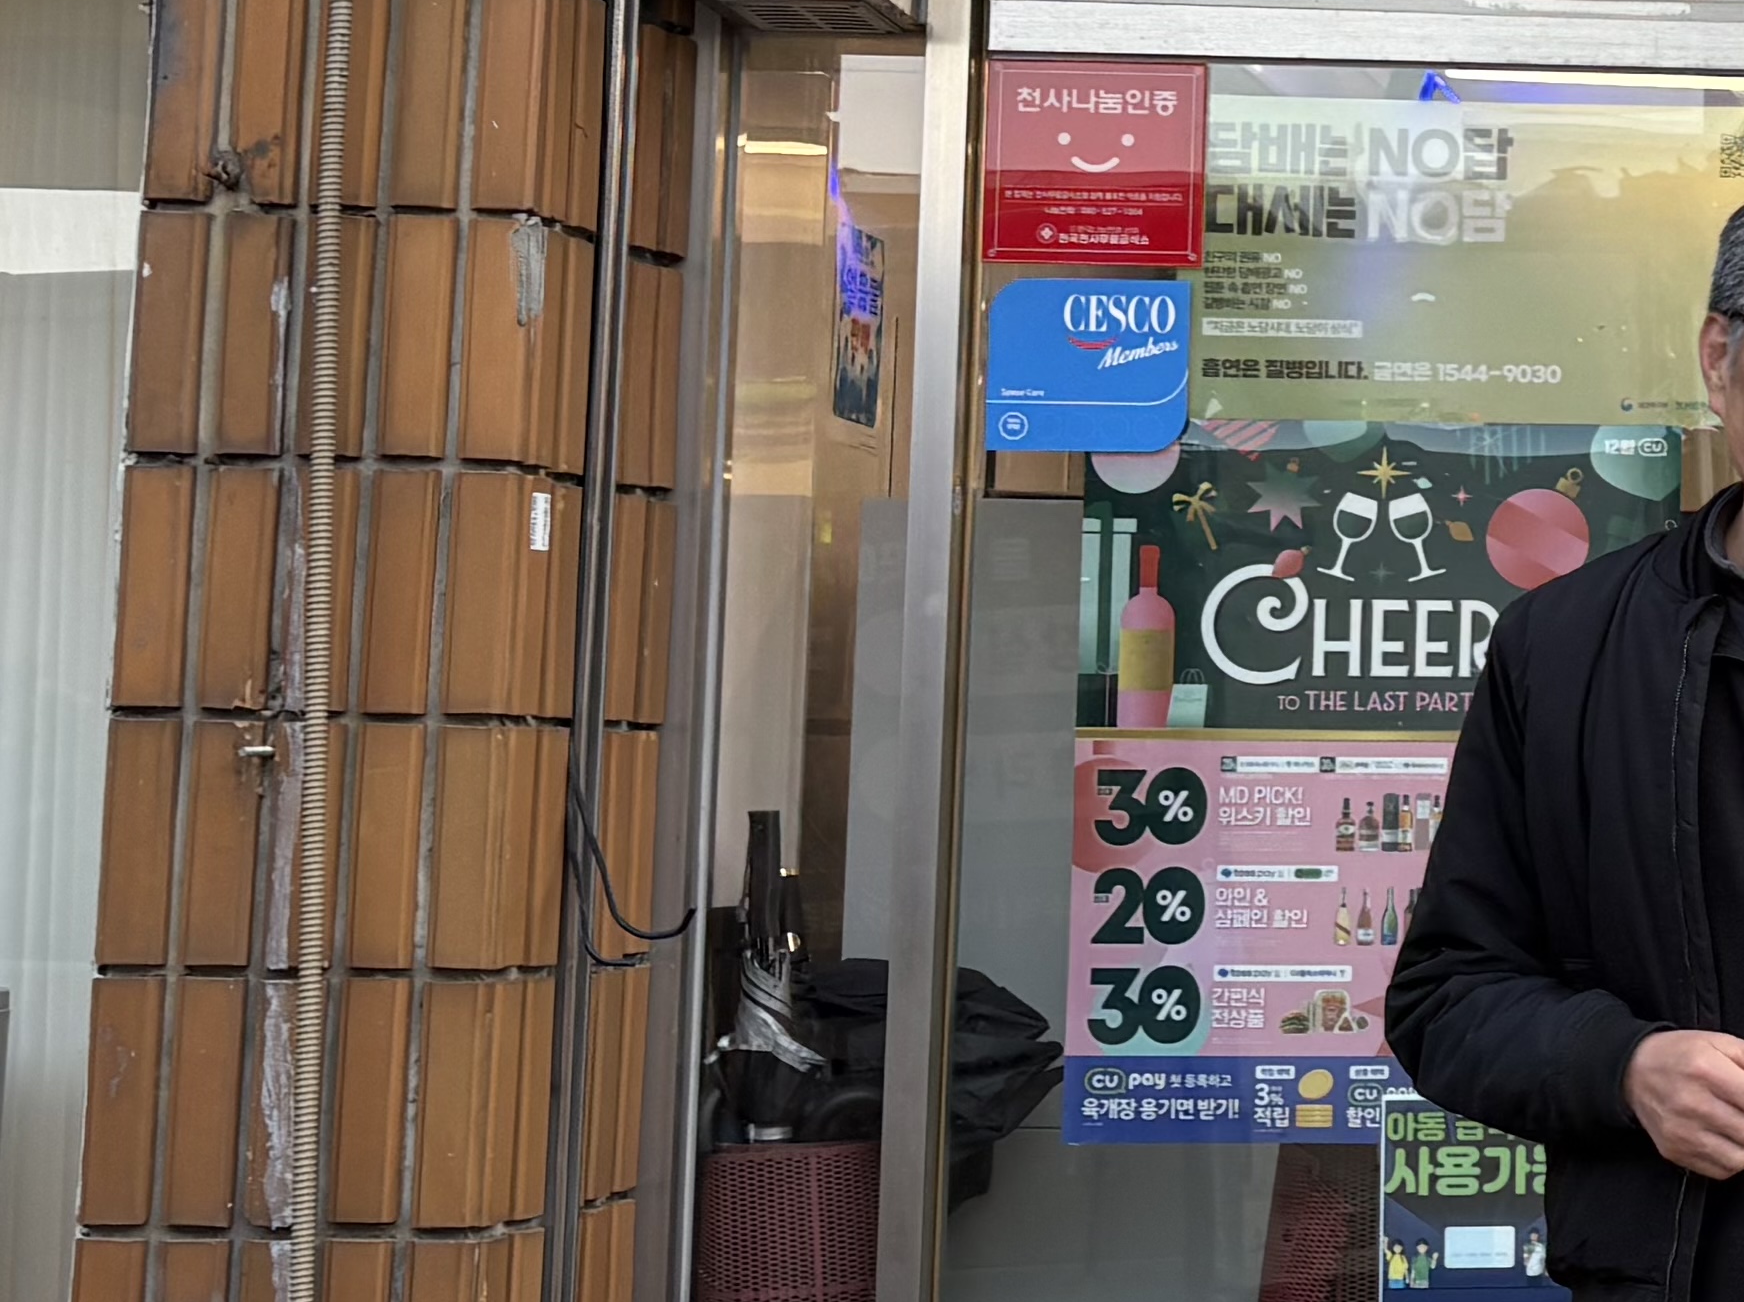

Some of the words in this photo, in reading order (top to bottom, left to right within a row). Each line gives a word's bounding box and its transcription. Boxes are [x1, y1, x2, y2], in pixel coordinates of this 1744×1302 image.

[1016, 86, 1178, 116] 천사나눔인증
[1207, 120, 1349, 177] 담배는
[1367, 127, 1514, 181] NO답
[1205, 183, 1356, 239] 대세는
[1366, 188, 1513, 246] NO담
[1263, 253, 1281, 263] NO
[1284, 268, 1303, 279] NO
[1289, 284, 1307, 294] NO
[1063, 294, 1176, 334] CESCO
[1272, 299, 1291, 309] NO
[1097, 337, 1179, 370] Members
[1201, 357, 1260, 378] 흡연은
[1265, 359, 1369, 380] 질병입니다.
[1373, 360, 1433, 382] 금연은
[1436, 362, 1562, 384] 1544-9030
[1604, 439, 1635, 455] 12월
[1277, 694, 1299, 710] TO
[1304, 690, 1347, 711] THE
[1353, 690, 1409, 712] LAST
[1219, 786, 1248, 804] MD
[1253, 786, 1304, 804] PICK!
[1218, 807, 1271, 826] 위스키
[1276, 807, 1312, 826] 할인
[1215, 887, 1250, 906] 와인
[1254, 888, 1268, 906] &
[1215, 908, 1267, 928] 샴페인
[1272, 908, 1308, 928] 할인
[1211, 987, 1265, 1007] 간편식
[1211, 1008, 1265, 1028] 전상품
[1128, 1072, 1166, 1089] pay
[1169, 1073, 1182, 1088] 첫
[1184, 1073, 1232, 1088] 등록하고
[1081, 1098, 1137, 1120] 육개장
[1139, 1098, 1195, 1120] 용기면
[1197, 1098, 1239, 1120] 받기!
[1253, 1107, 1290, 1127] 적립
[1346, 1107, 1381, 1127] 할인
[1387, 1112, 1446, 1141] 아동
